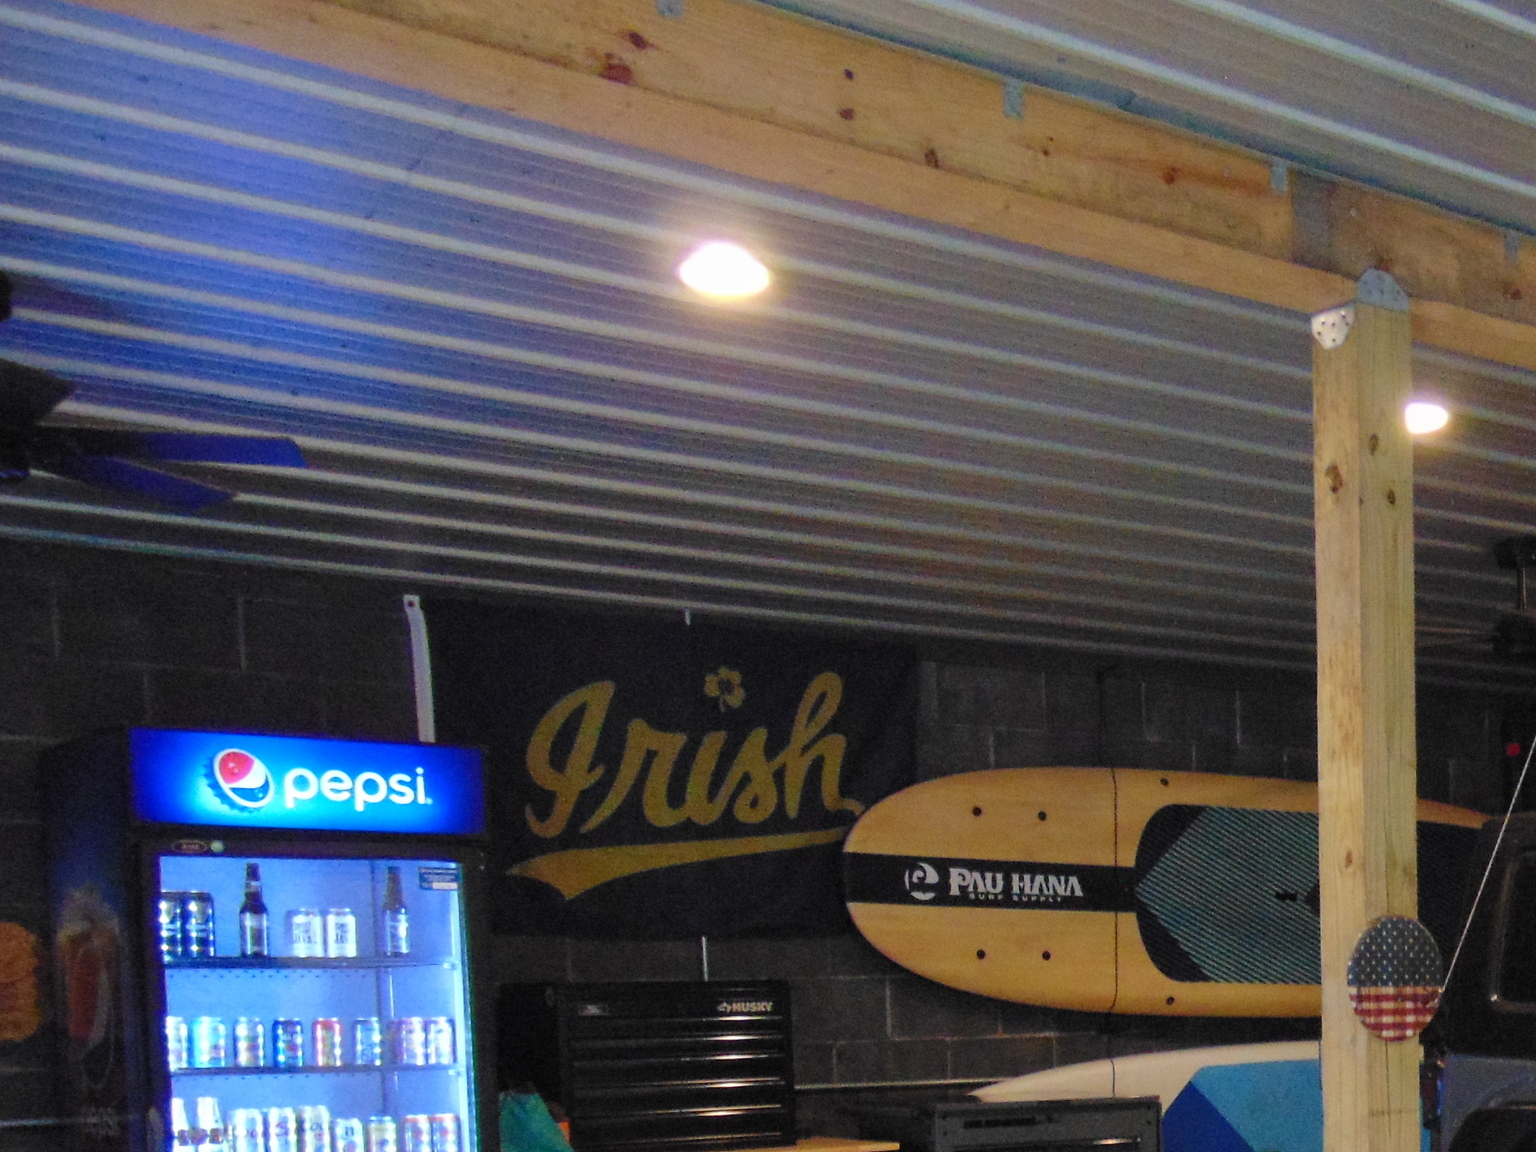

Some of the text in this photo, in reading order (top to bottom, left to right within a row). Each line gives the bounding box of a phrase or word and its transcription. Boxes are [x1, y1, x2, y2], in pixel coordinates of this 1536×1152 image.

[525, 667, 865, 838] Irish
[283, 767, 428, 812] pepsi
[948, 867, 1083, 897] PAU HANA
[731, 1002, 773, 1012] HUSKY
